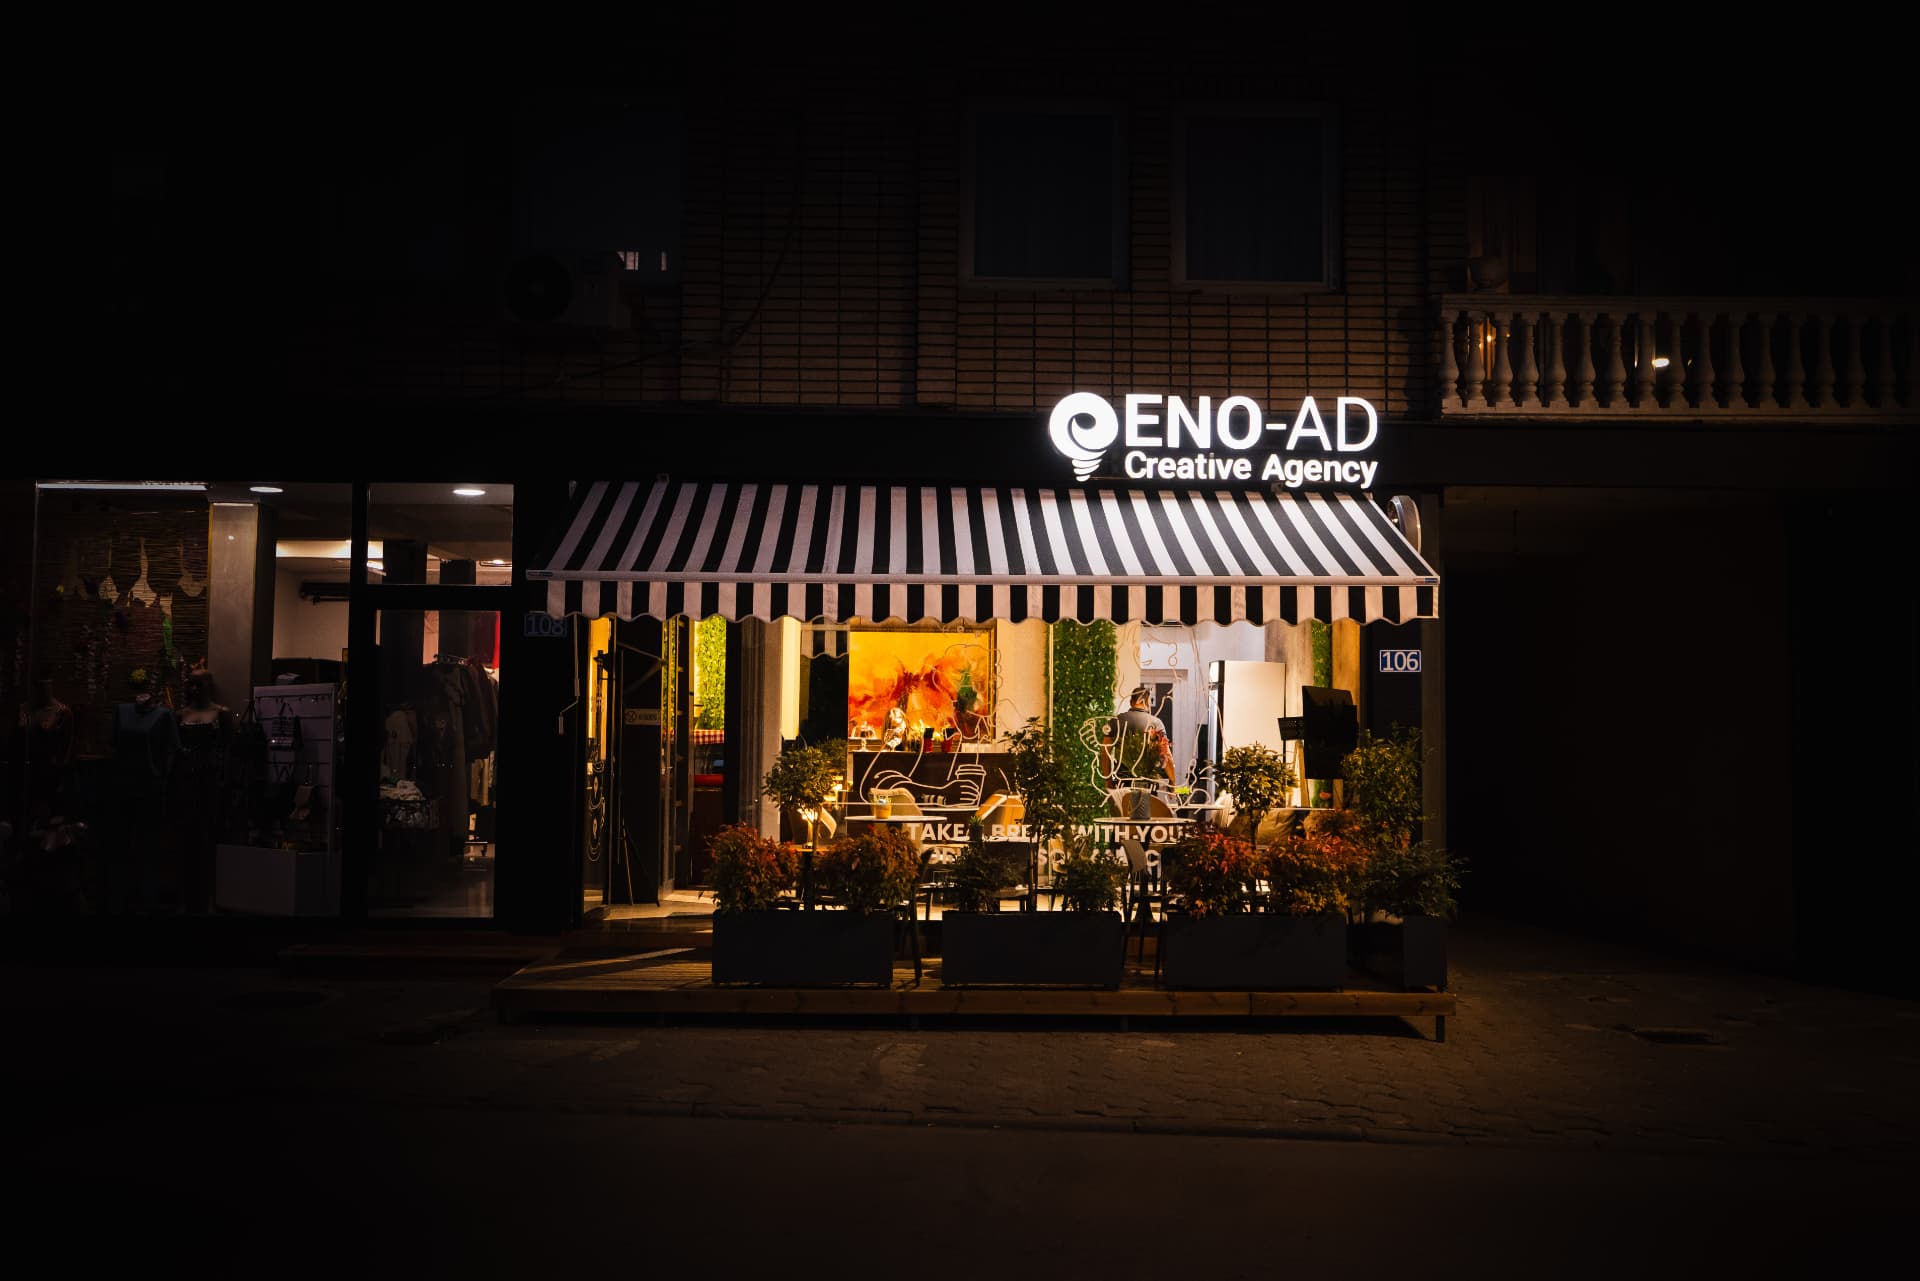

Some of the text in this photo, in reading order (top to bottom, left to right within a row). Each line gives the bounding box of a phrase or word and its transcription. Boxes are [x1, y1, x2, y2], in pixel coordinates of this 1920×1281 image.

[1124, 393, 1378, 452] ENO-AD
[1124, 450, 1378, 489] Creative Agency
[1382, 651, 1419, 671] 106
[905, 822, 966, 841] TAKE
